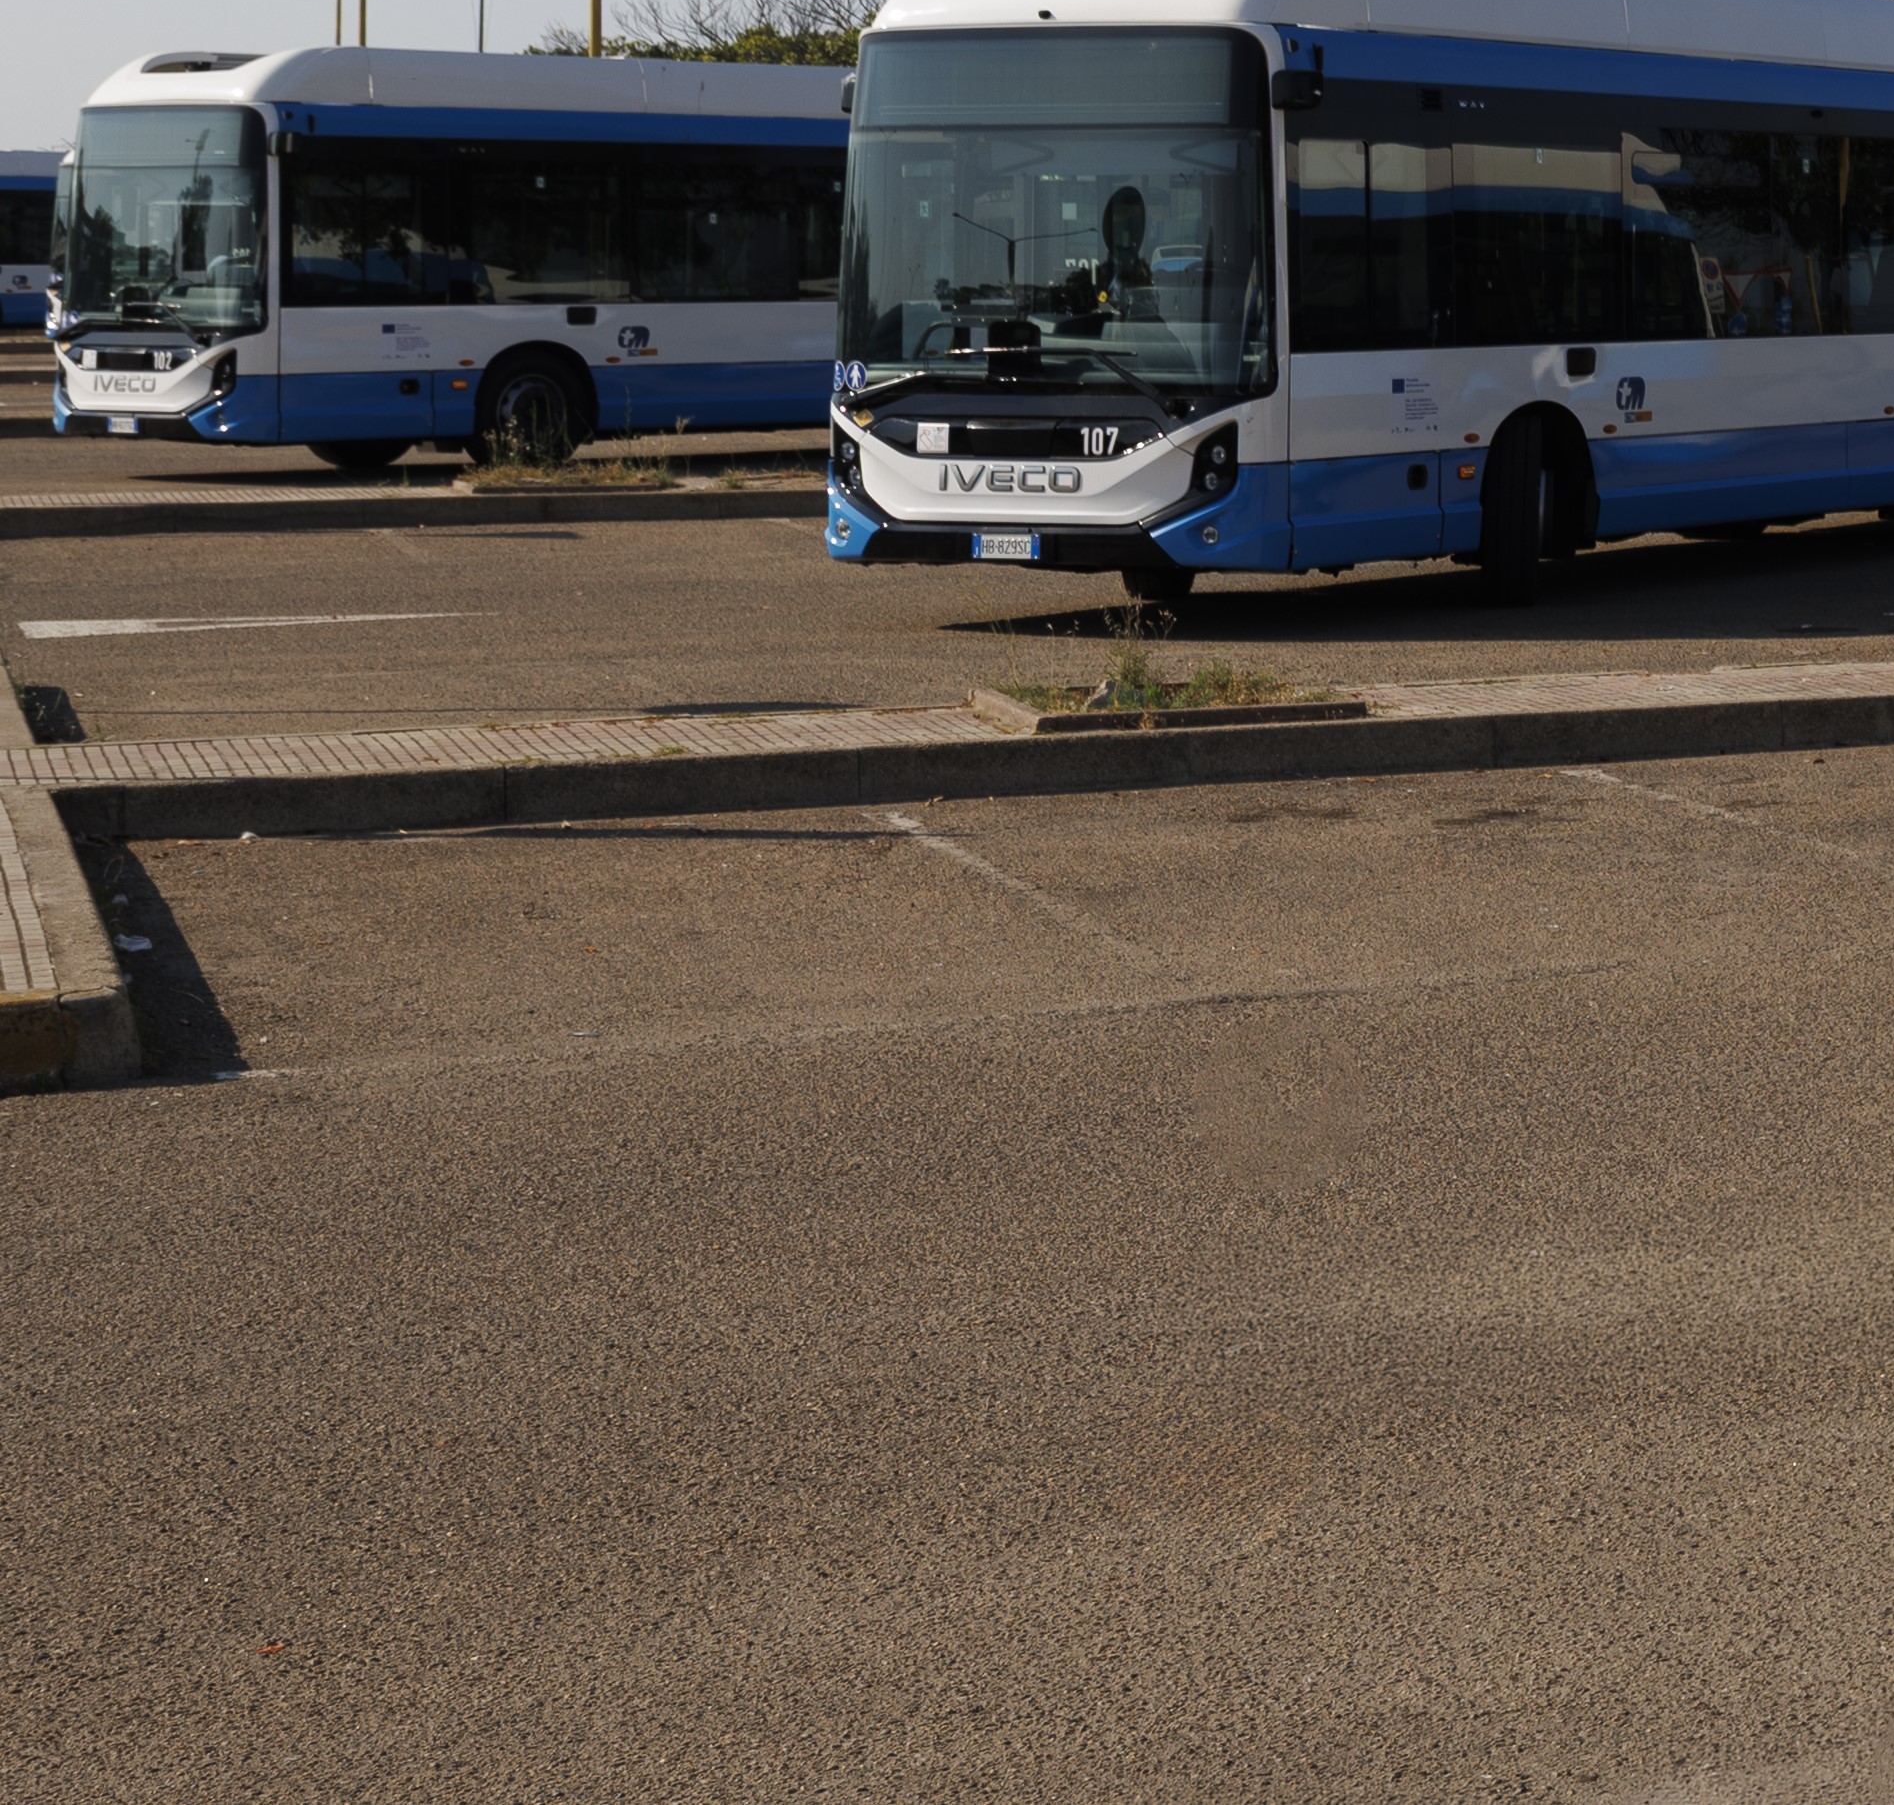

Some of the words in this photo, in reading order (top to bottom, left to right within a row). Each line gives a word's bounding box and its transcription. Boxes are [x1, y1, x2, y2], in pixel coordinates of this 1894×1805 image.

[153, 350, 173, 370] 102
[94, 373, 157, 393] IVECO
[1080, 426, 1119, 456] 107
[938, 463, 1082, 493] IVECO
